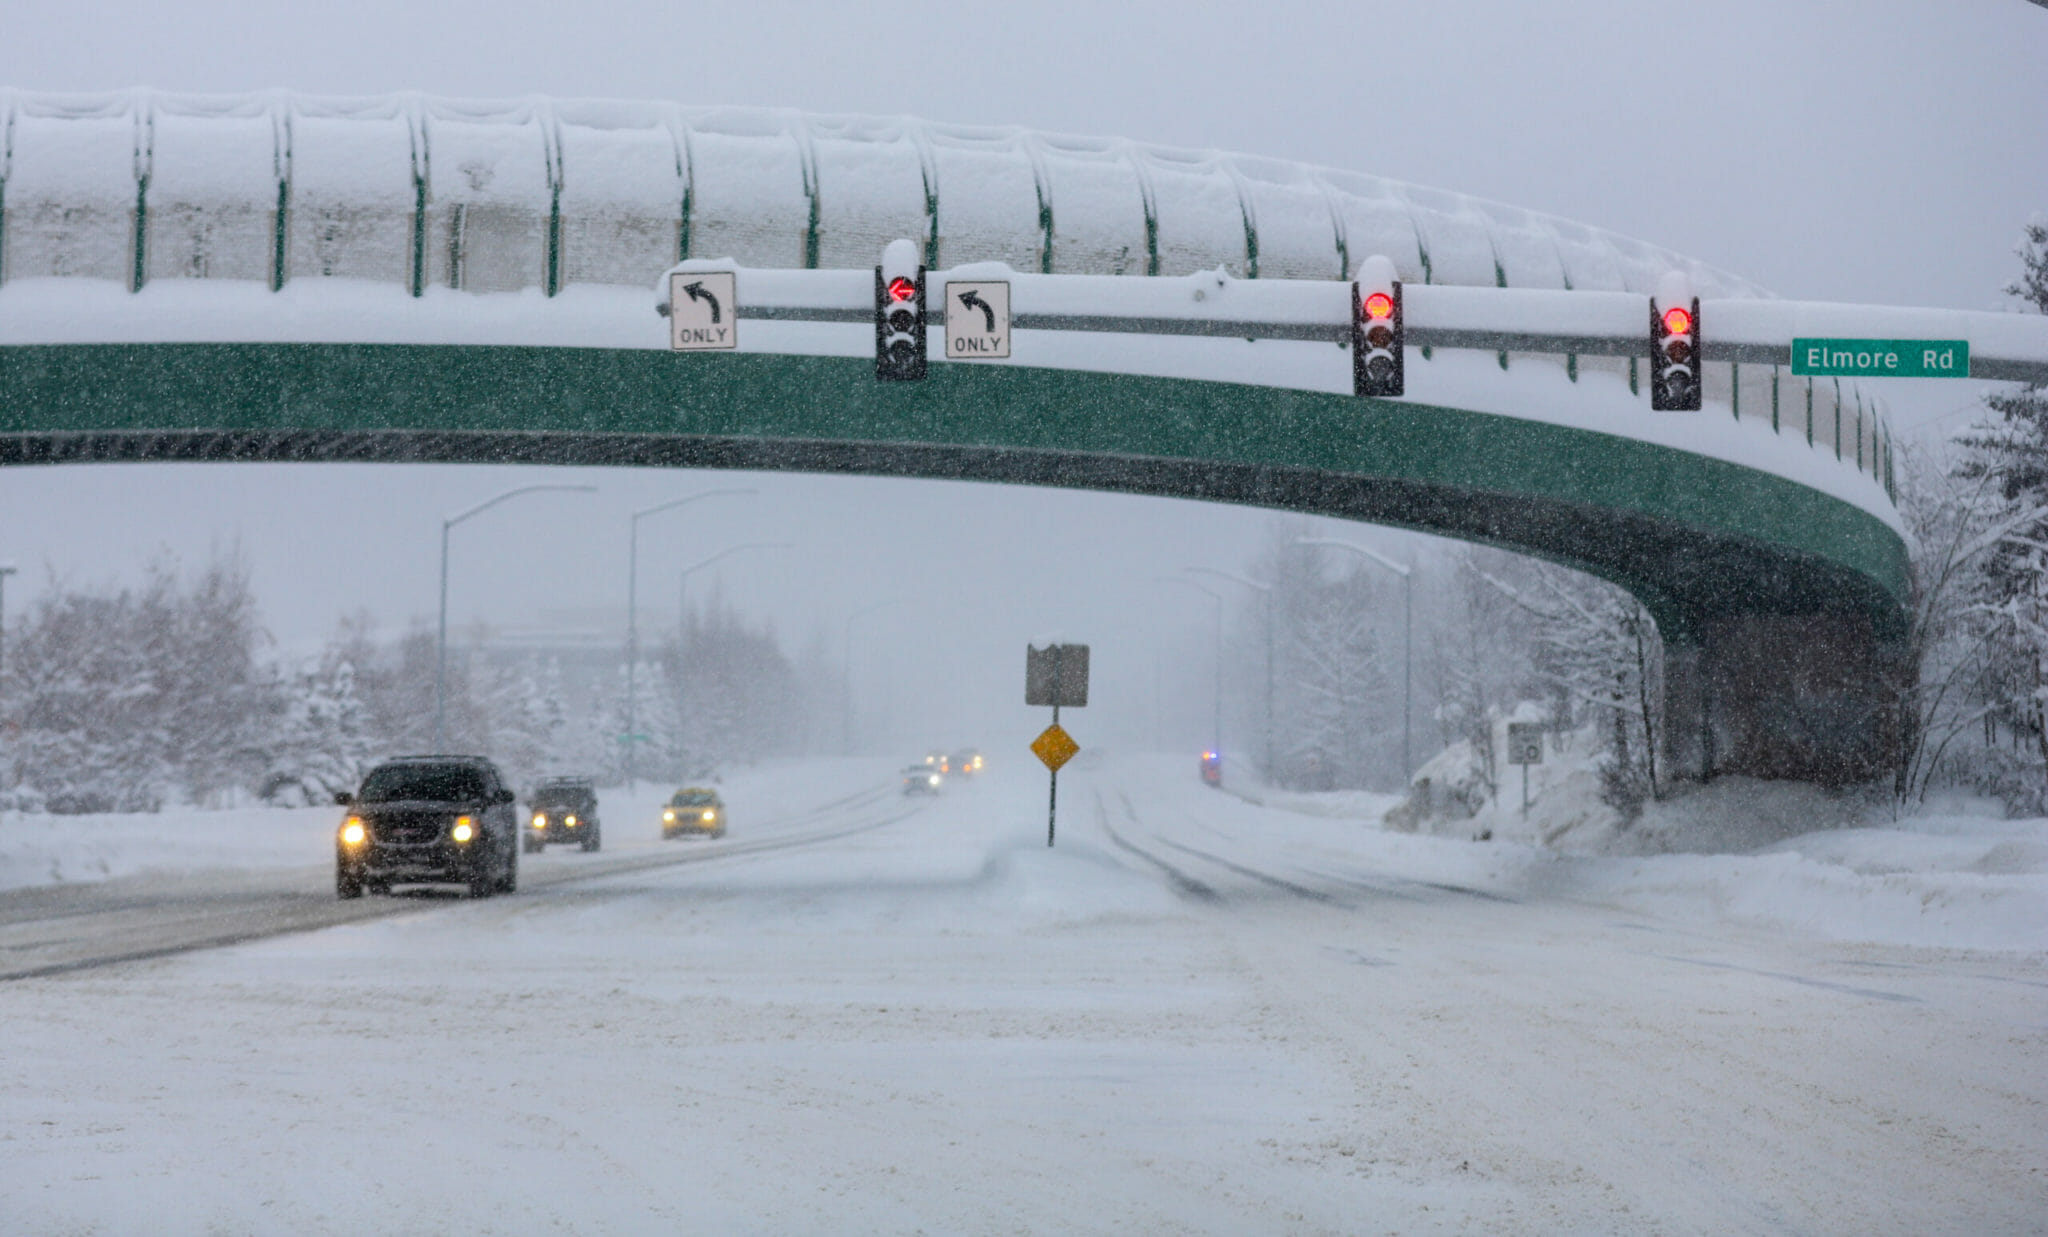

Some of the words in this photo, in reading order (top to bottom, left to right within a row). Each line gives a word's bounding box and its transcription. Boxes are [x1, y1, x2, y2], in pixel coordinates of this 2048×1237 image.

[681, 328, 727, 342] ONLY
[955, 337, 1001, 352] ONLY
[1807, 348, 1898, 368] Elmore
[1923, 349, 1954, 369] Rd
